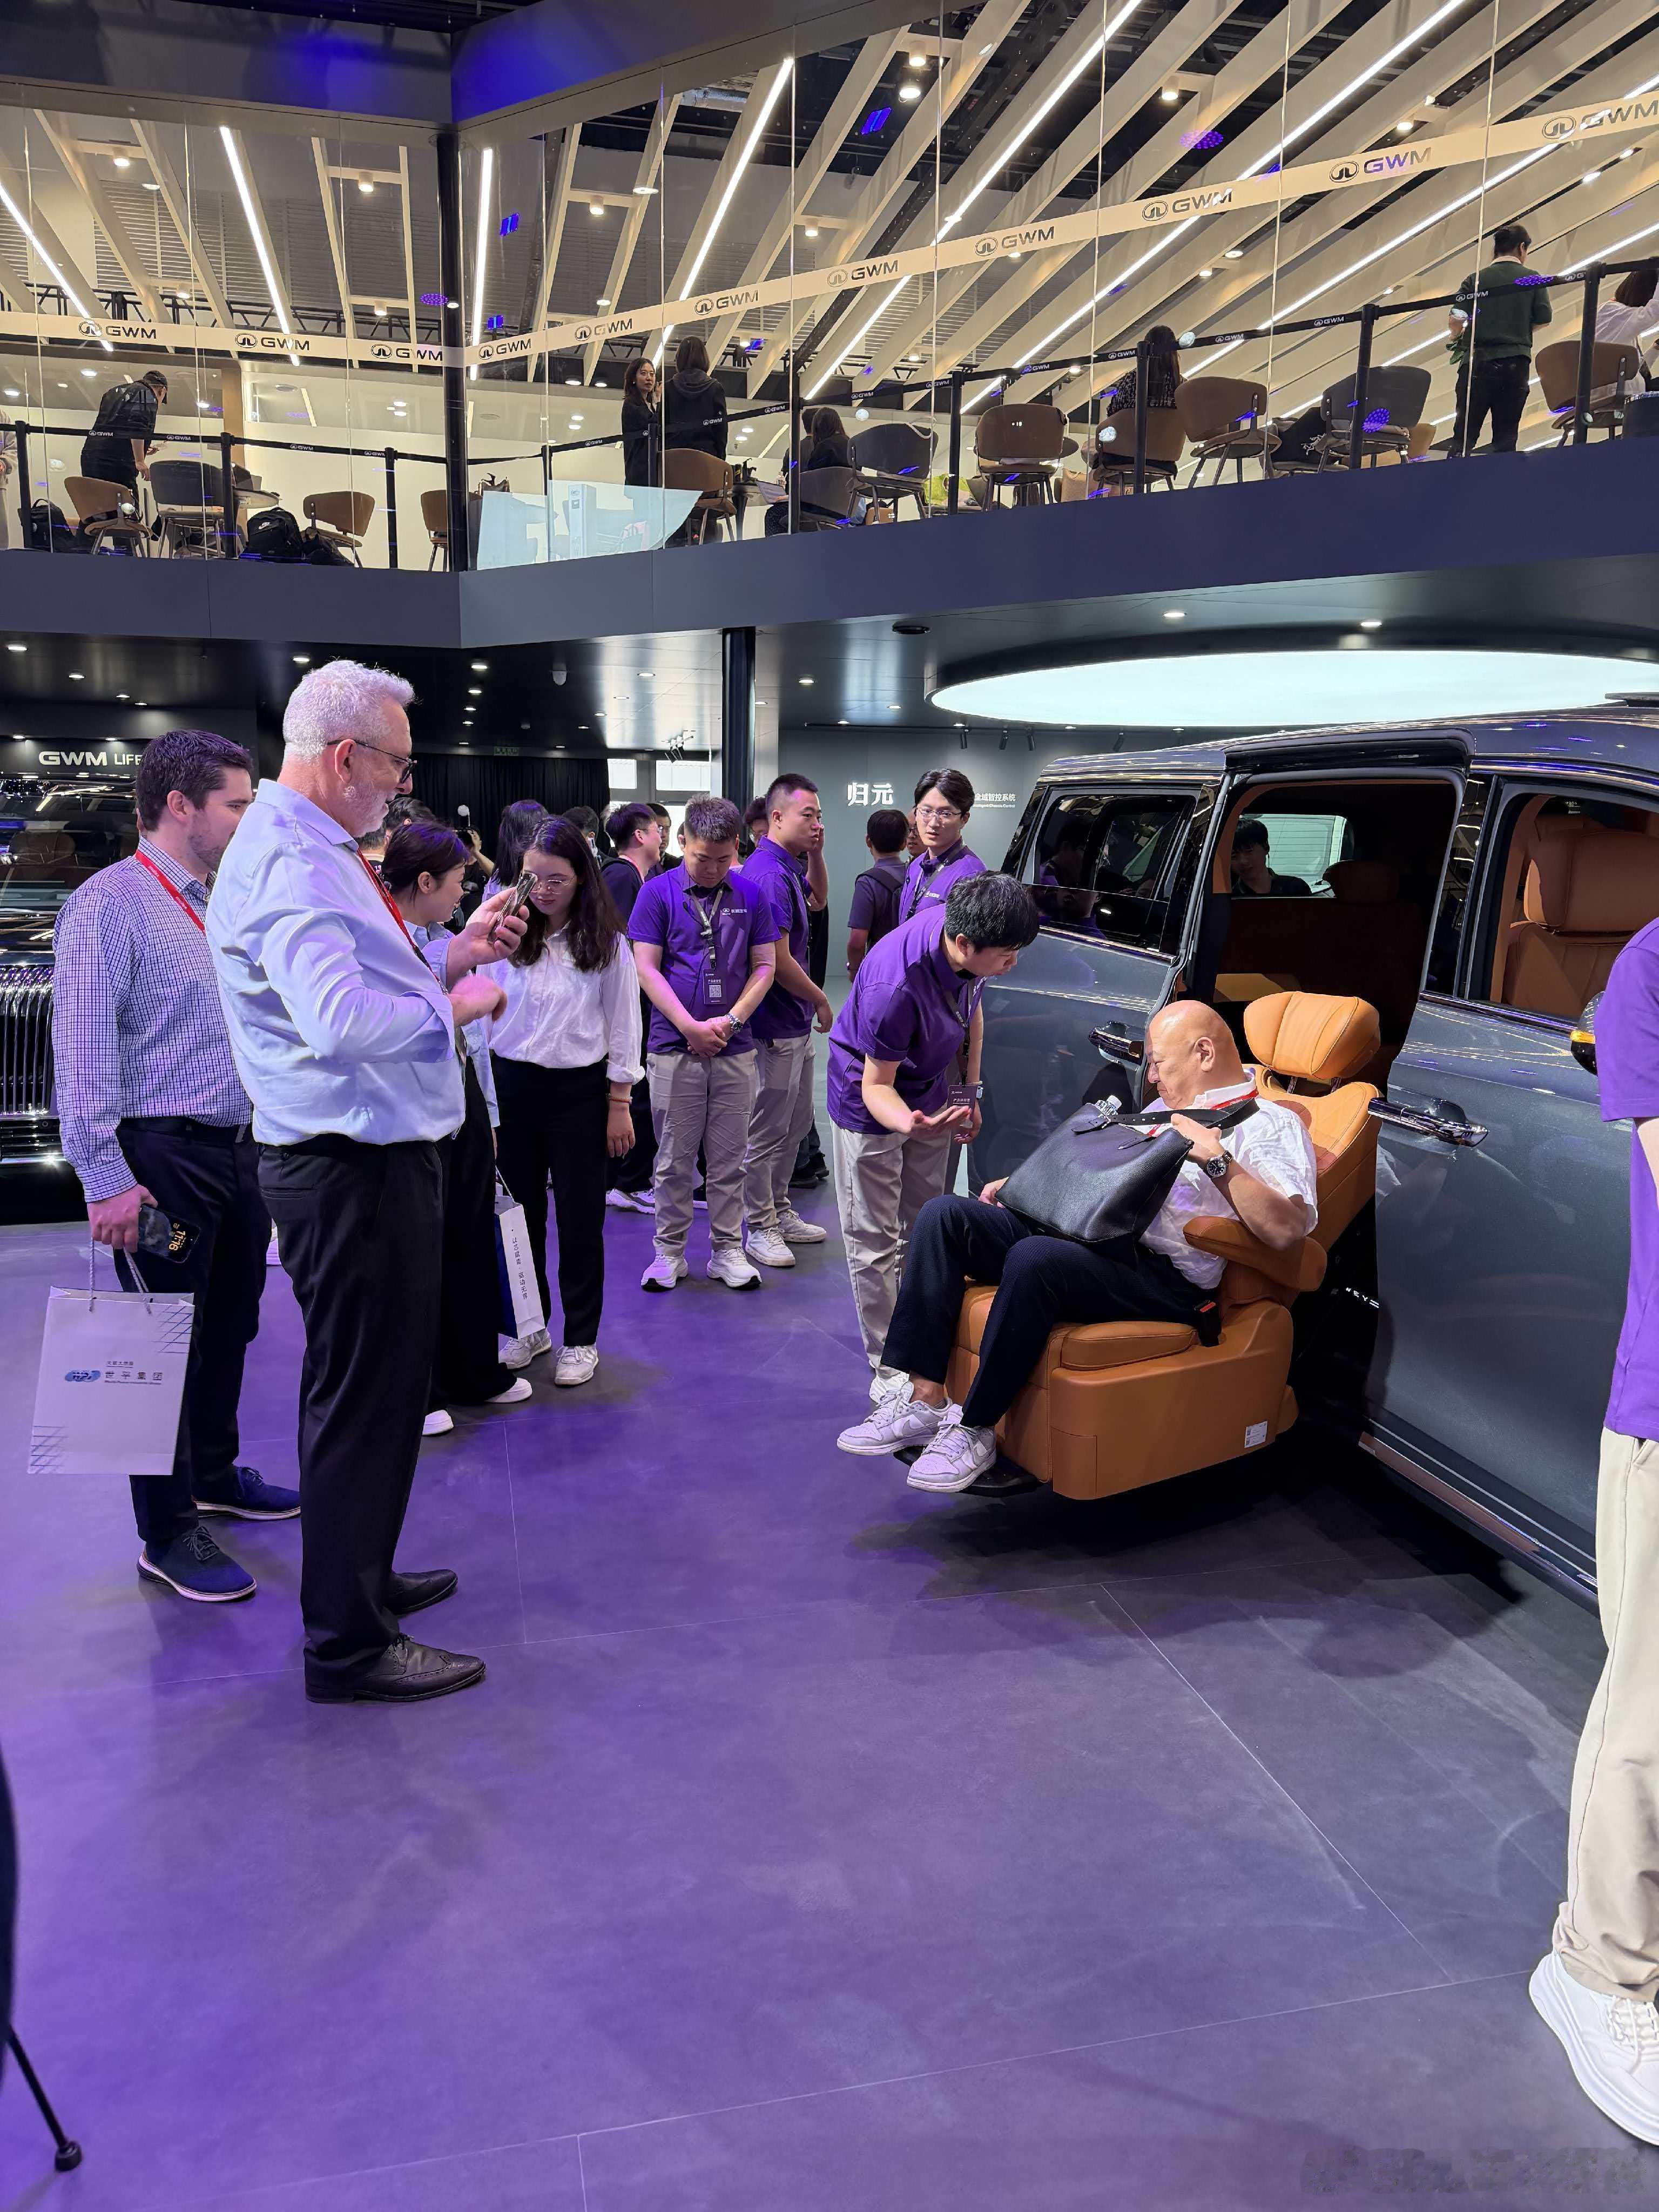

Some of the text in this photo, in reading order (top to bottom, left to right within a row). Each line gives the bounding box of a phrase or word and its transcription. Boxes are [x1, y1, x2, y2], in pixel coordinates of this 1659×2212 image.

[1580, 100, 1659, 131] GWM
[1364, 147, 1431, 173] GWM
[1172, 188, 1232, 213] GWM
[1001, 226, 1054, 249] GWM
[851, 260, 898, 280] GWM
[716, 292, 758, 309] GWM
[1467, 291, 1489, 299] GWM
[106, 326, 157, 339] GWM
[594, 319, 632, 335] GWM
[261, 338, 310, 350] GWM
[496, 339, 531, 354] GWM
[396, 348, 443, 361] GWM
[39, 751, 107, 766] GWM
[847, 782, 894, 806] 归元
[974, 793, 1016, 801] 全域智控系统
